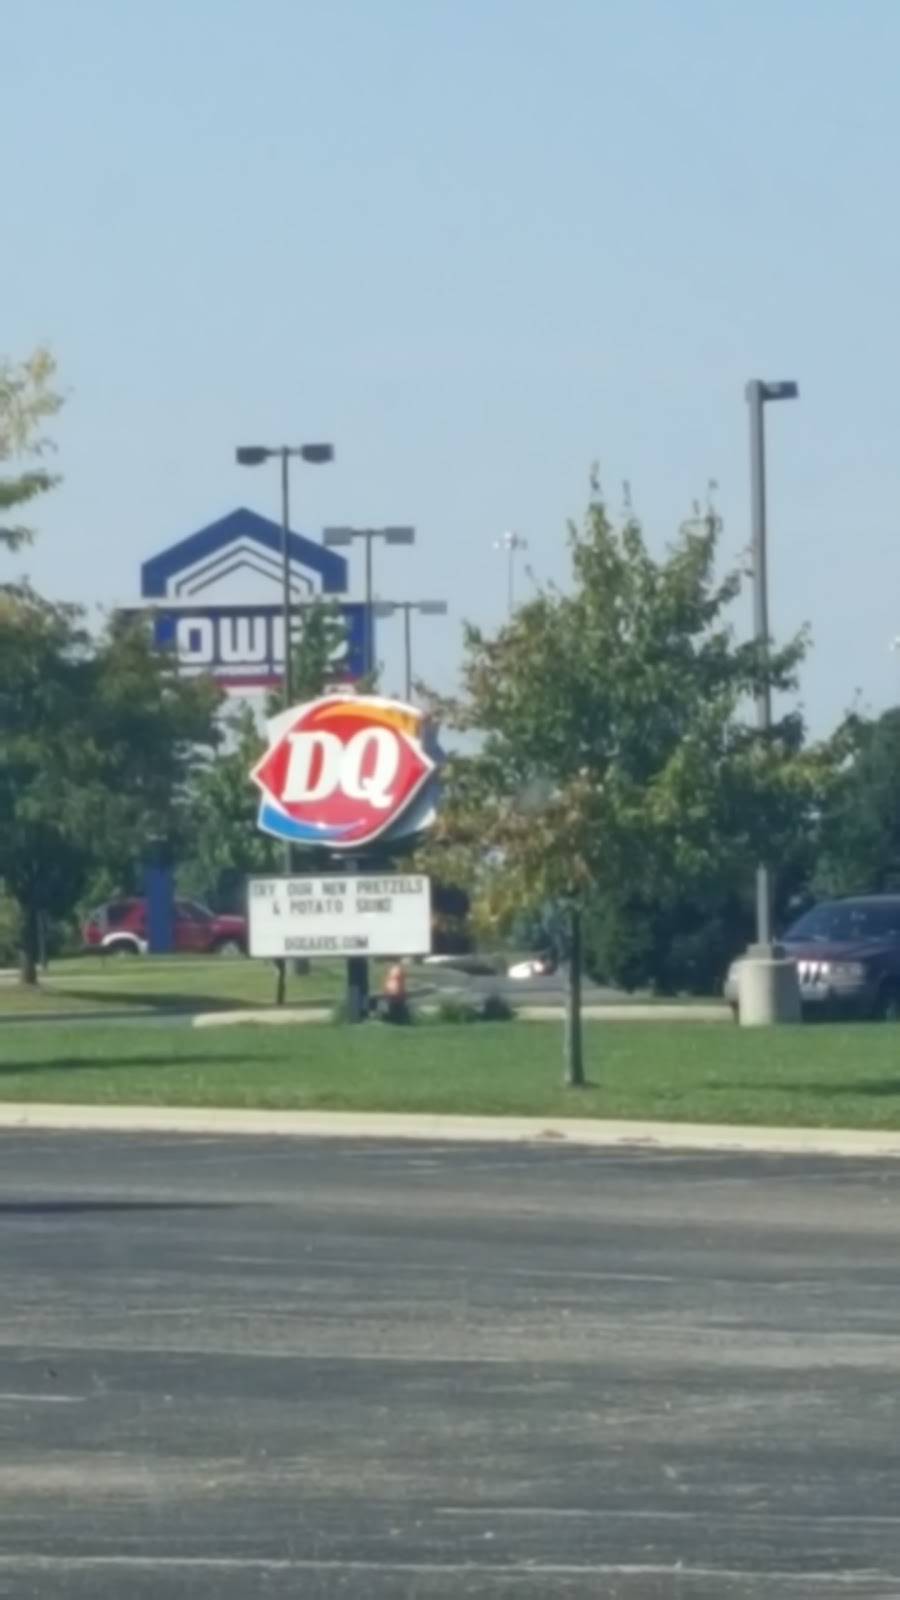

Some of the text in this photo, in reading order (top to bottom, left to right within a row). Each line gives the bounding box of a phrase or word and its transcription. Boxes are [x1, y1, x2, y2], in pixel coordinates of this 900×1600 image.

[280, 724, 400, 809] DQ
[254, 879, 423, 896] TRY OUR NEW PRETZELS
[290, 898, 343, 915] POTATO
